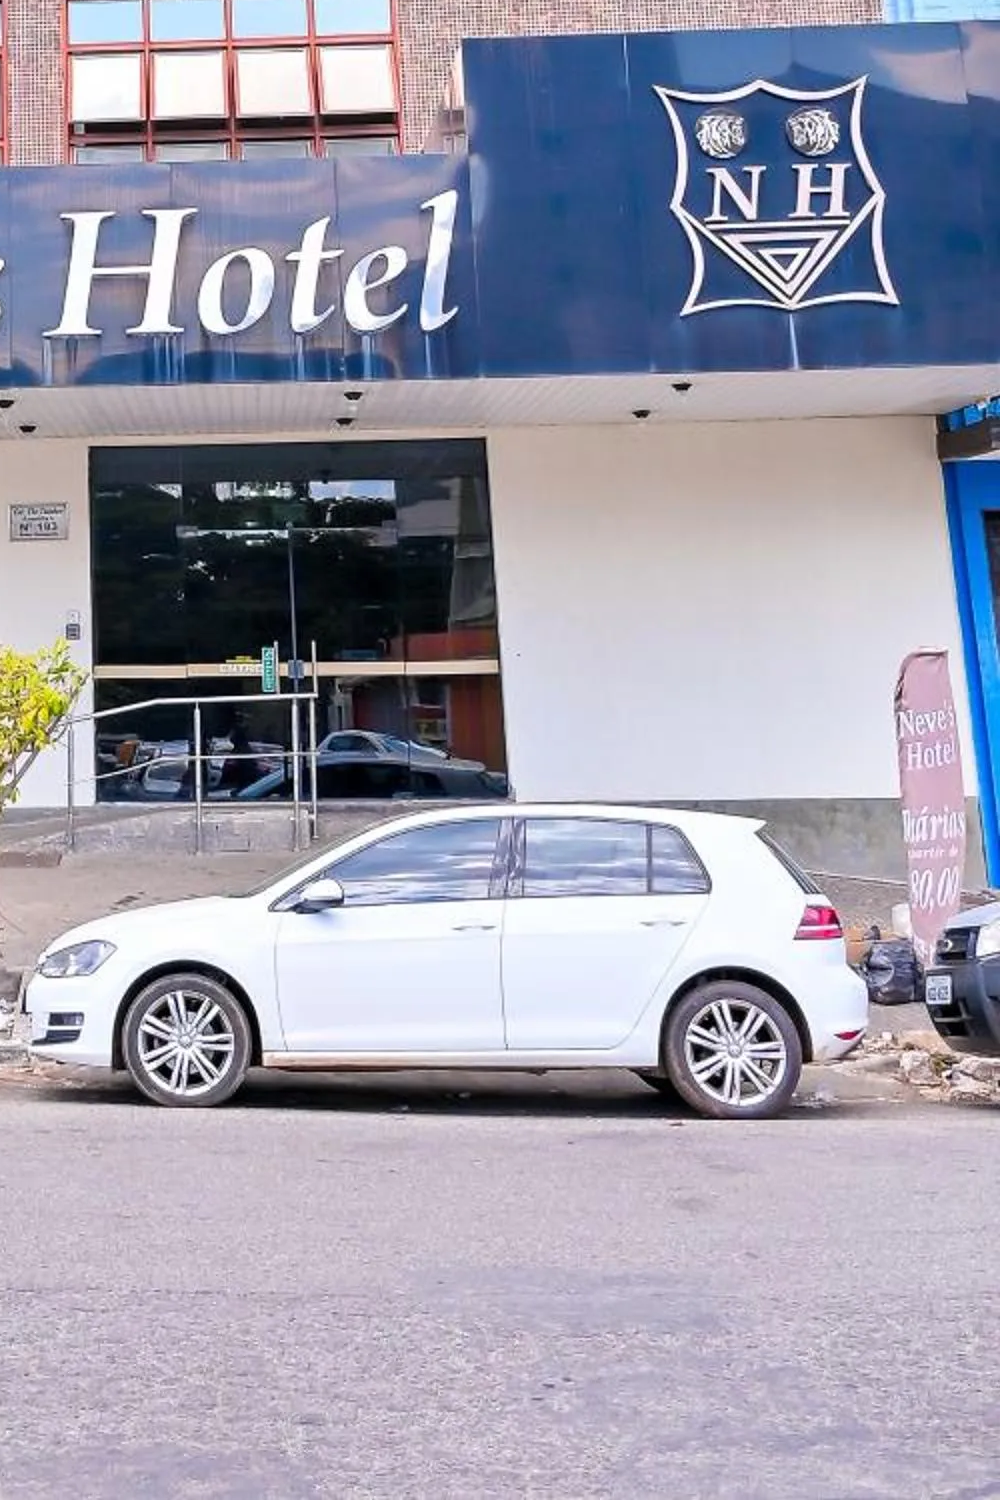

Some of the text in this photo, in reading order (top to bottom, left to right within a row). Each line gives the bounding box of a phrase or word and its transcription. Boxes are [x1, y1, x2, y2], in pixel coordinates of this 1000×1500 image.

[41, 189, 460, 336] Hotel
[898, 699, 955, 738] Neve's
[905, 736, 956, 770] Hotel
